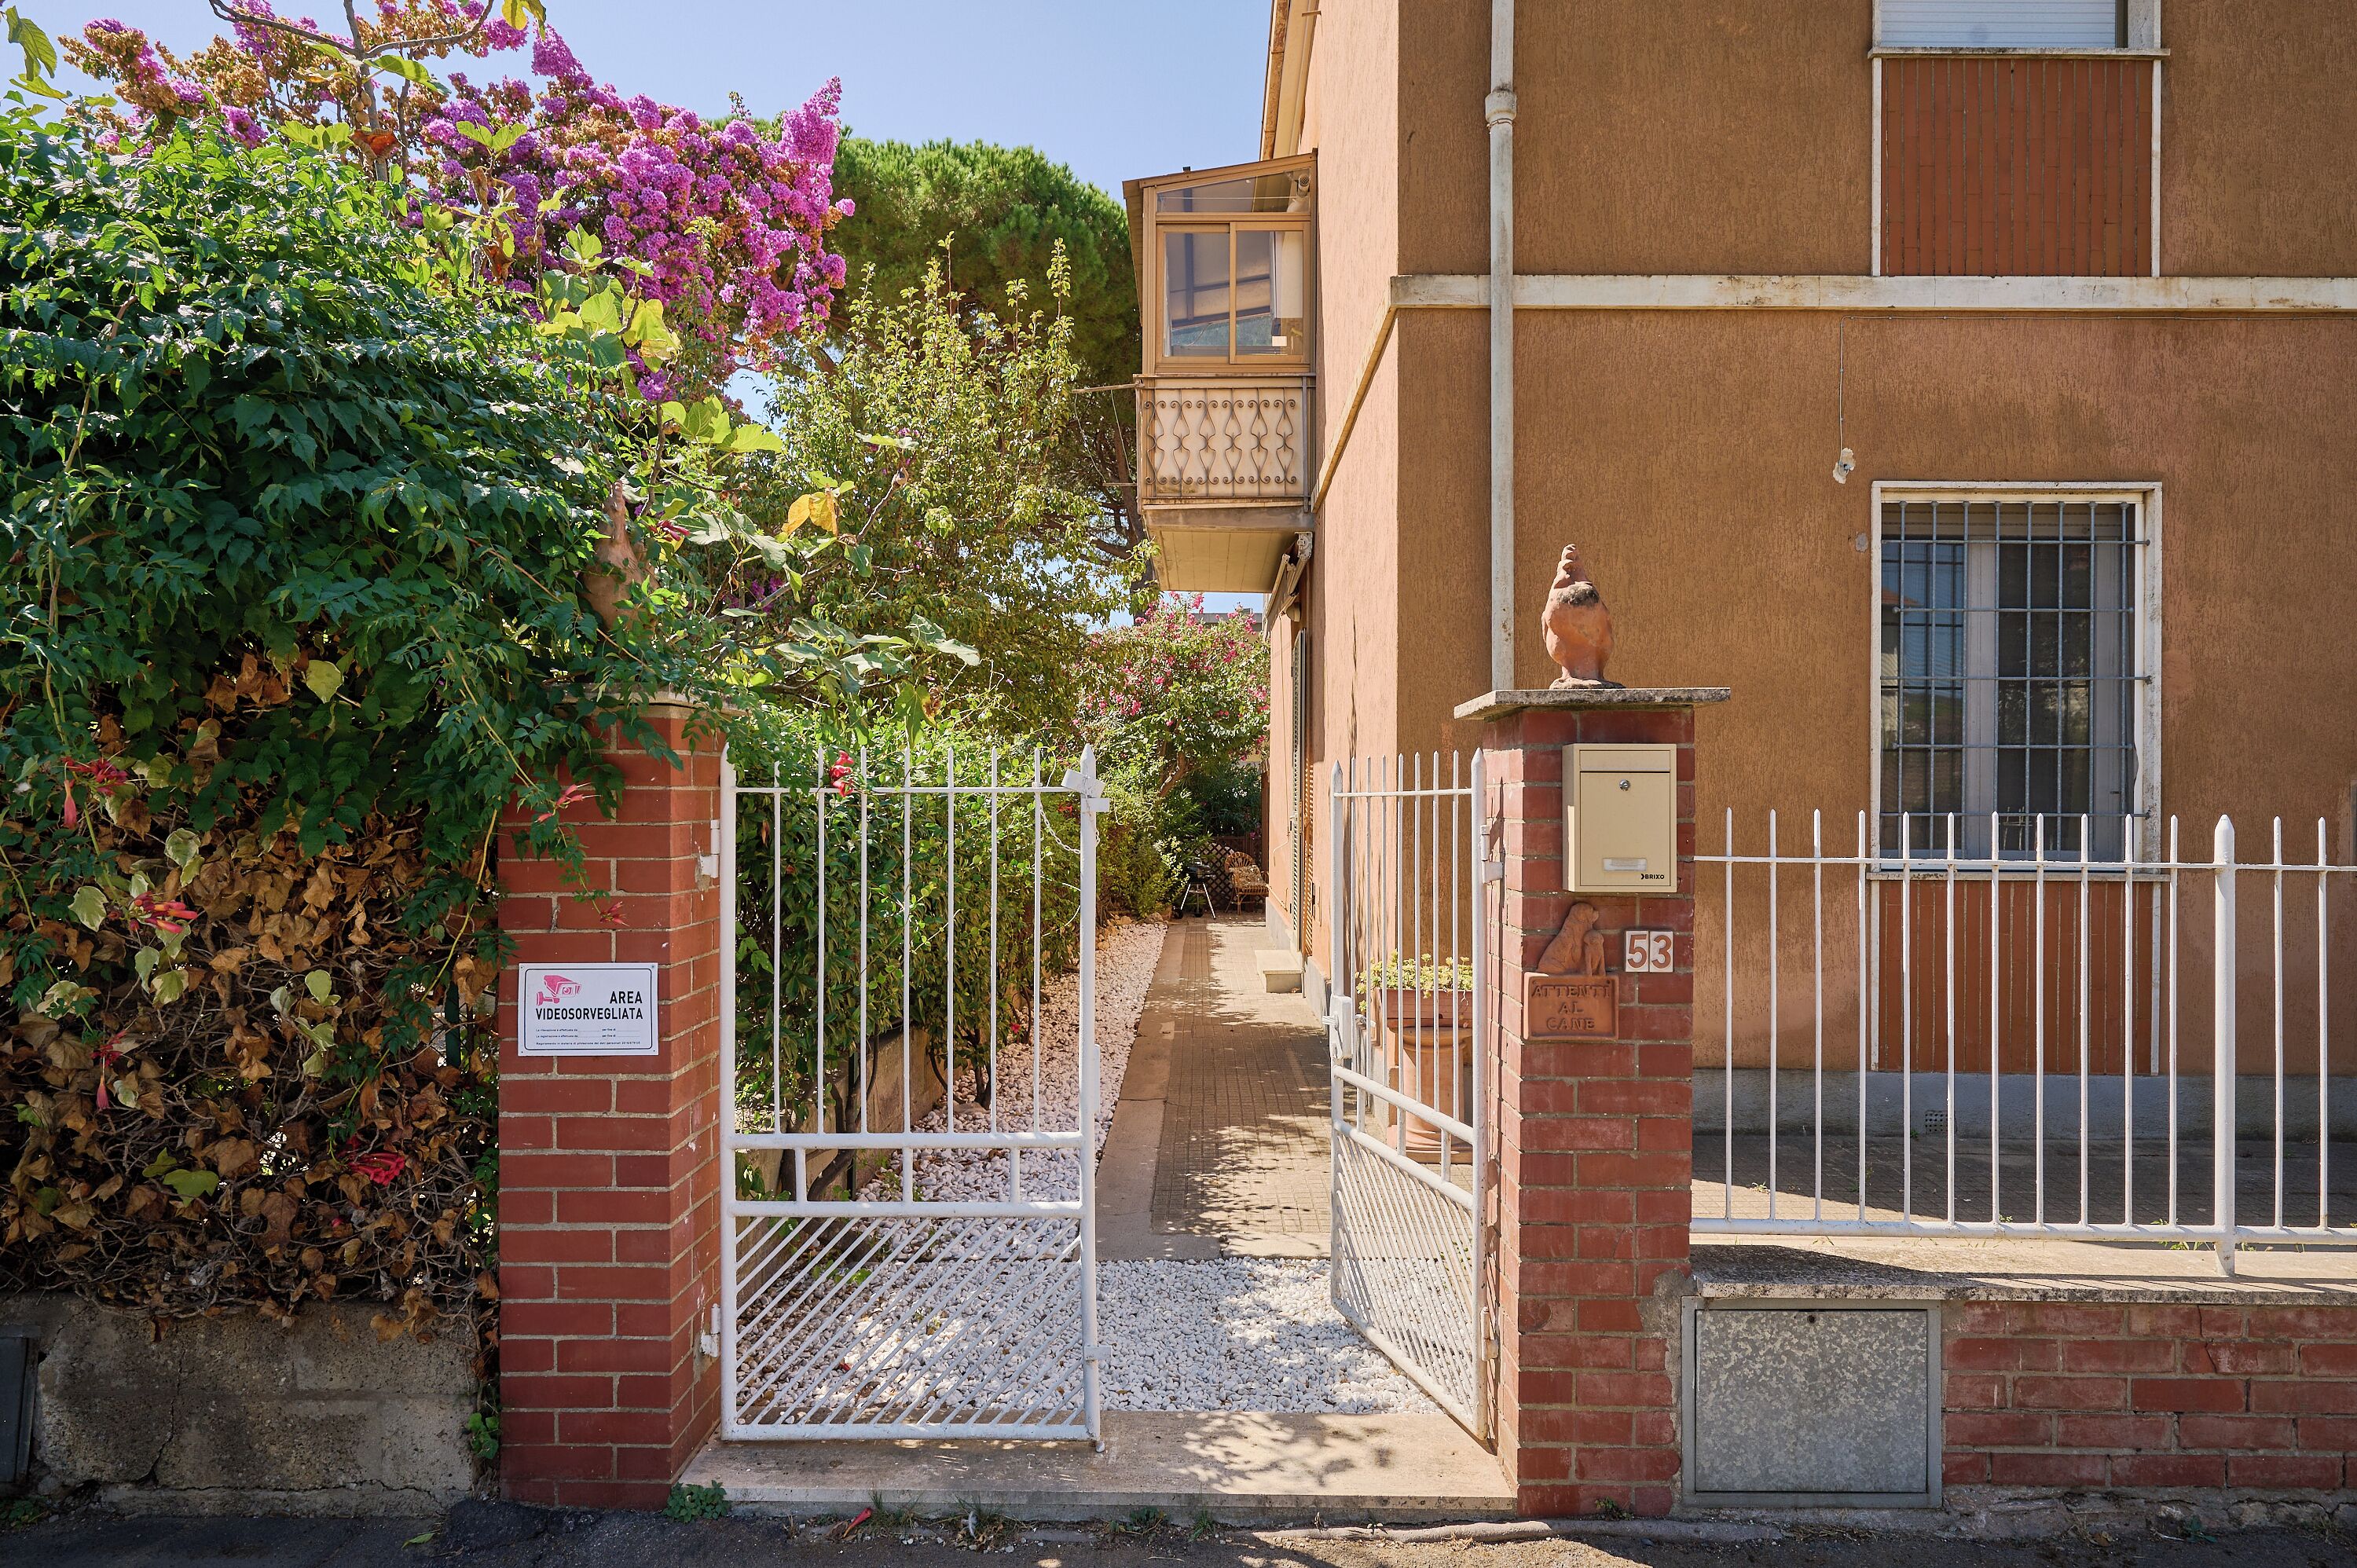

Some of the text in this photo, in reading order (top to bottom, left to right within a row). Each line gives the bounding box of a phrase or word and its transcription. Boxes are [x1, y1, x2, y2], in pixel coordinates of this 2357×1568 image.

[1627, 934, 1672, 969] 53
[609, 991, 643, 1004] AREA
[1531, 984, 1610, 998] ATTENTI
[536, 1007, 643, 1020] VIDEOSORVEGLIATA
[1558, 1002, 1584, 1014] AL
[1546, 1017, 1596, 1031] CANE
